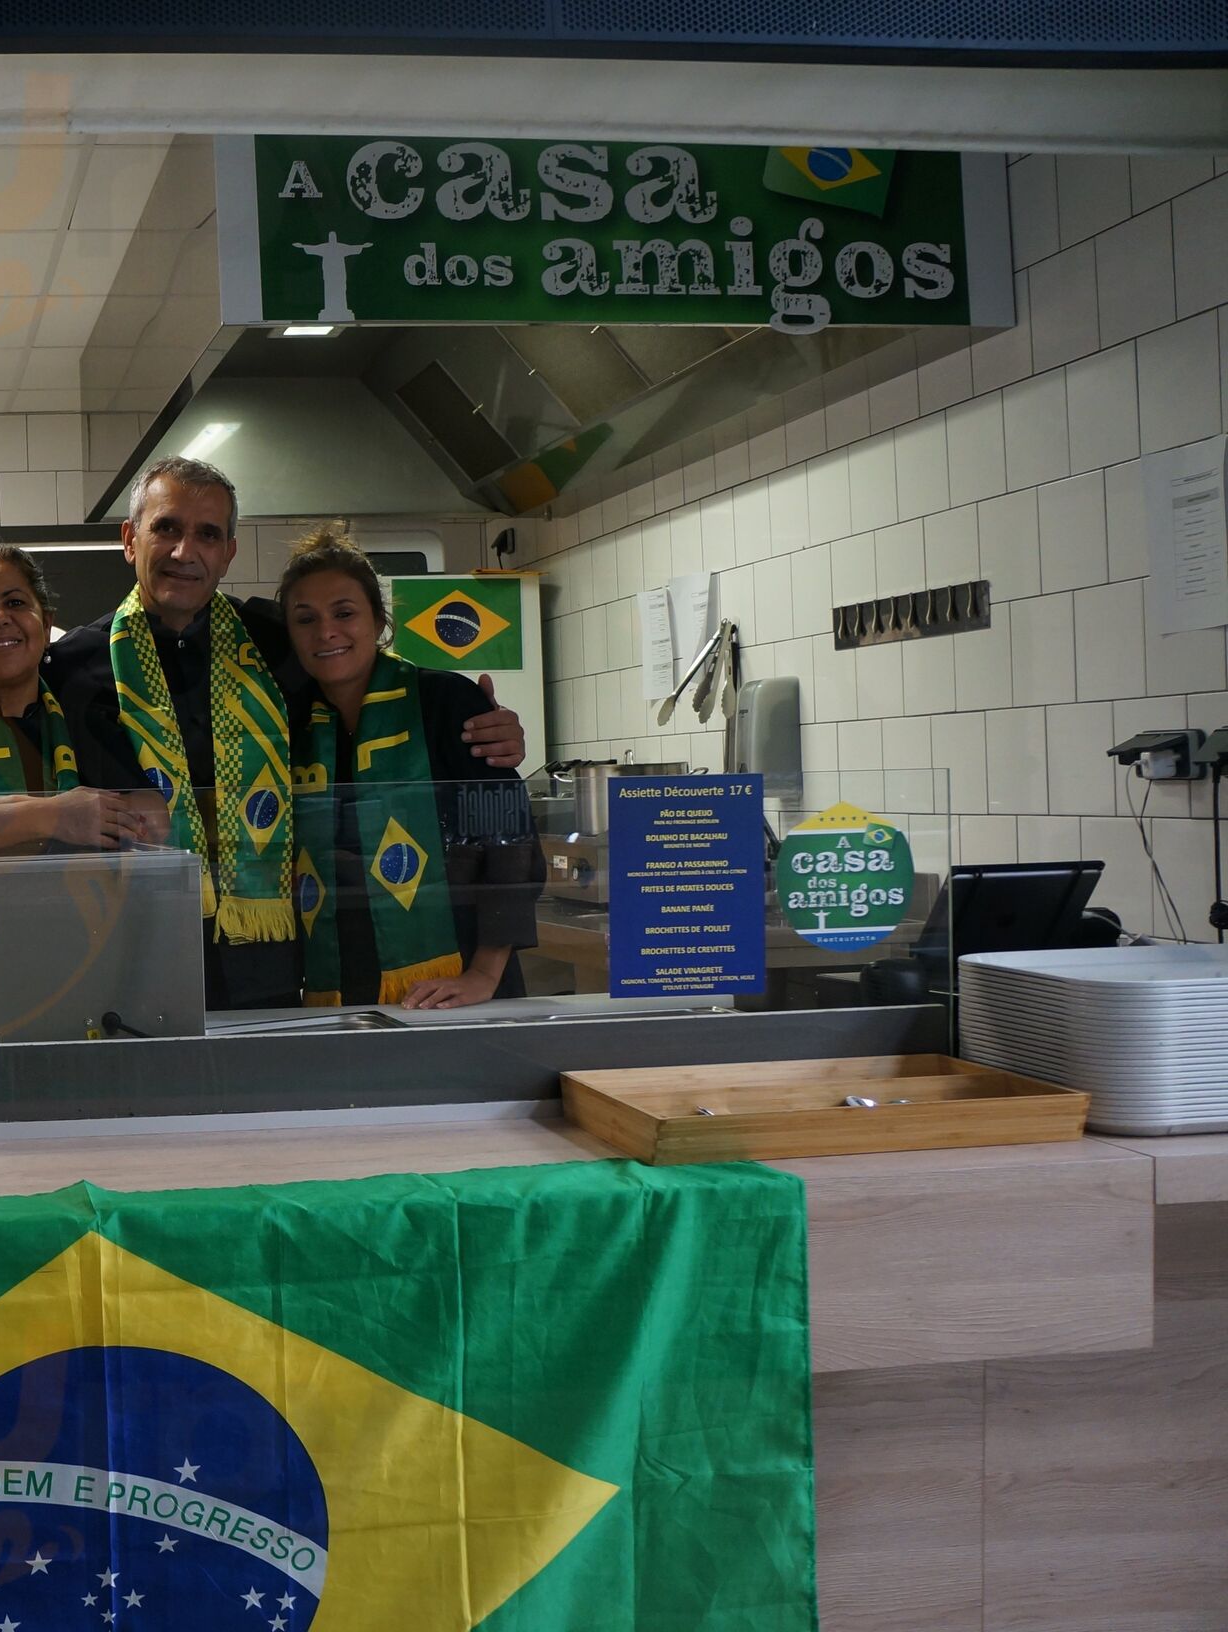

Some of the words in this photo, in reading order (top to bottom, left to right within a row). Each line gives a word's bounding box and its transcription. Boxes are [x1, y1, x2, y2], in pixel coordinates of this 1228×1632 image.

[277, 157, 324, 200] A
[403, 241, 514, 289] dos
[541, 215, 955, 336] amigos
[619, 786, 661, 798] Assiette
[664, 785, 724, 797] Découverte
[730, 785, 741, 795] 17
[744, 784, 752, 795] €
[660, 809, 674, 818] PÃO
[687, 809, 713, 817] QUEIJO
[690, 833, 728, 841] BACALHAU
[836, 836, 851, 848] A
[684, 860, 729, 868] PASSARINHO
[791, 850, 894, 873] casa
[808, 877, 837, 888] dos
[641, 885, 664, 893] FRITES
[676, 884, 704, 892] PATATES
[705, 883, 734, 891] DOUCES
[788, 884, 904, 916] amigos
[691, 904, 714, 912] PANÉE
[645, 926, 689, 934] BROCHETTES
[640, 947, 686, 955] BROCHETTES
[698, 945, 736, 953] CREVETTES
[684, 966, 723, 974] VINAGRETE
[74, 1476, 95, 1502] E
[105, 1481, 316, 1571] PROGRESSO
